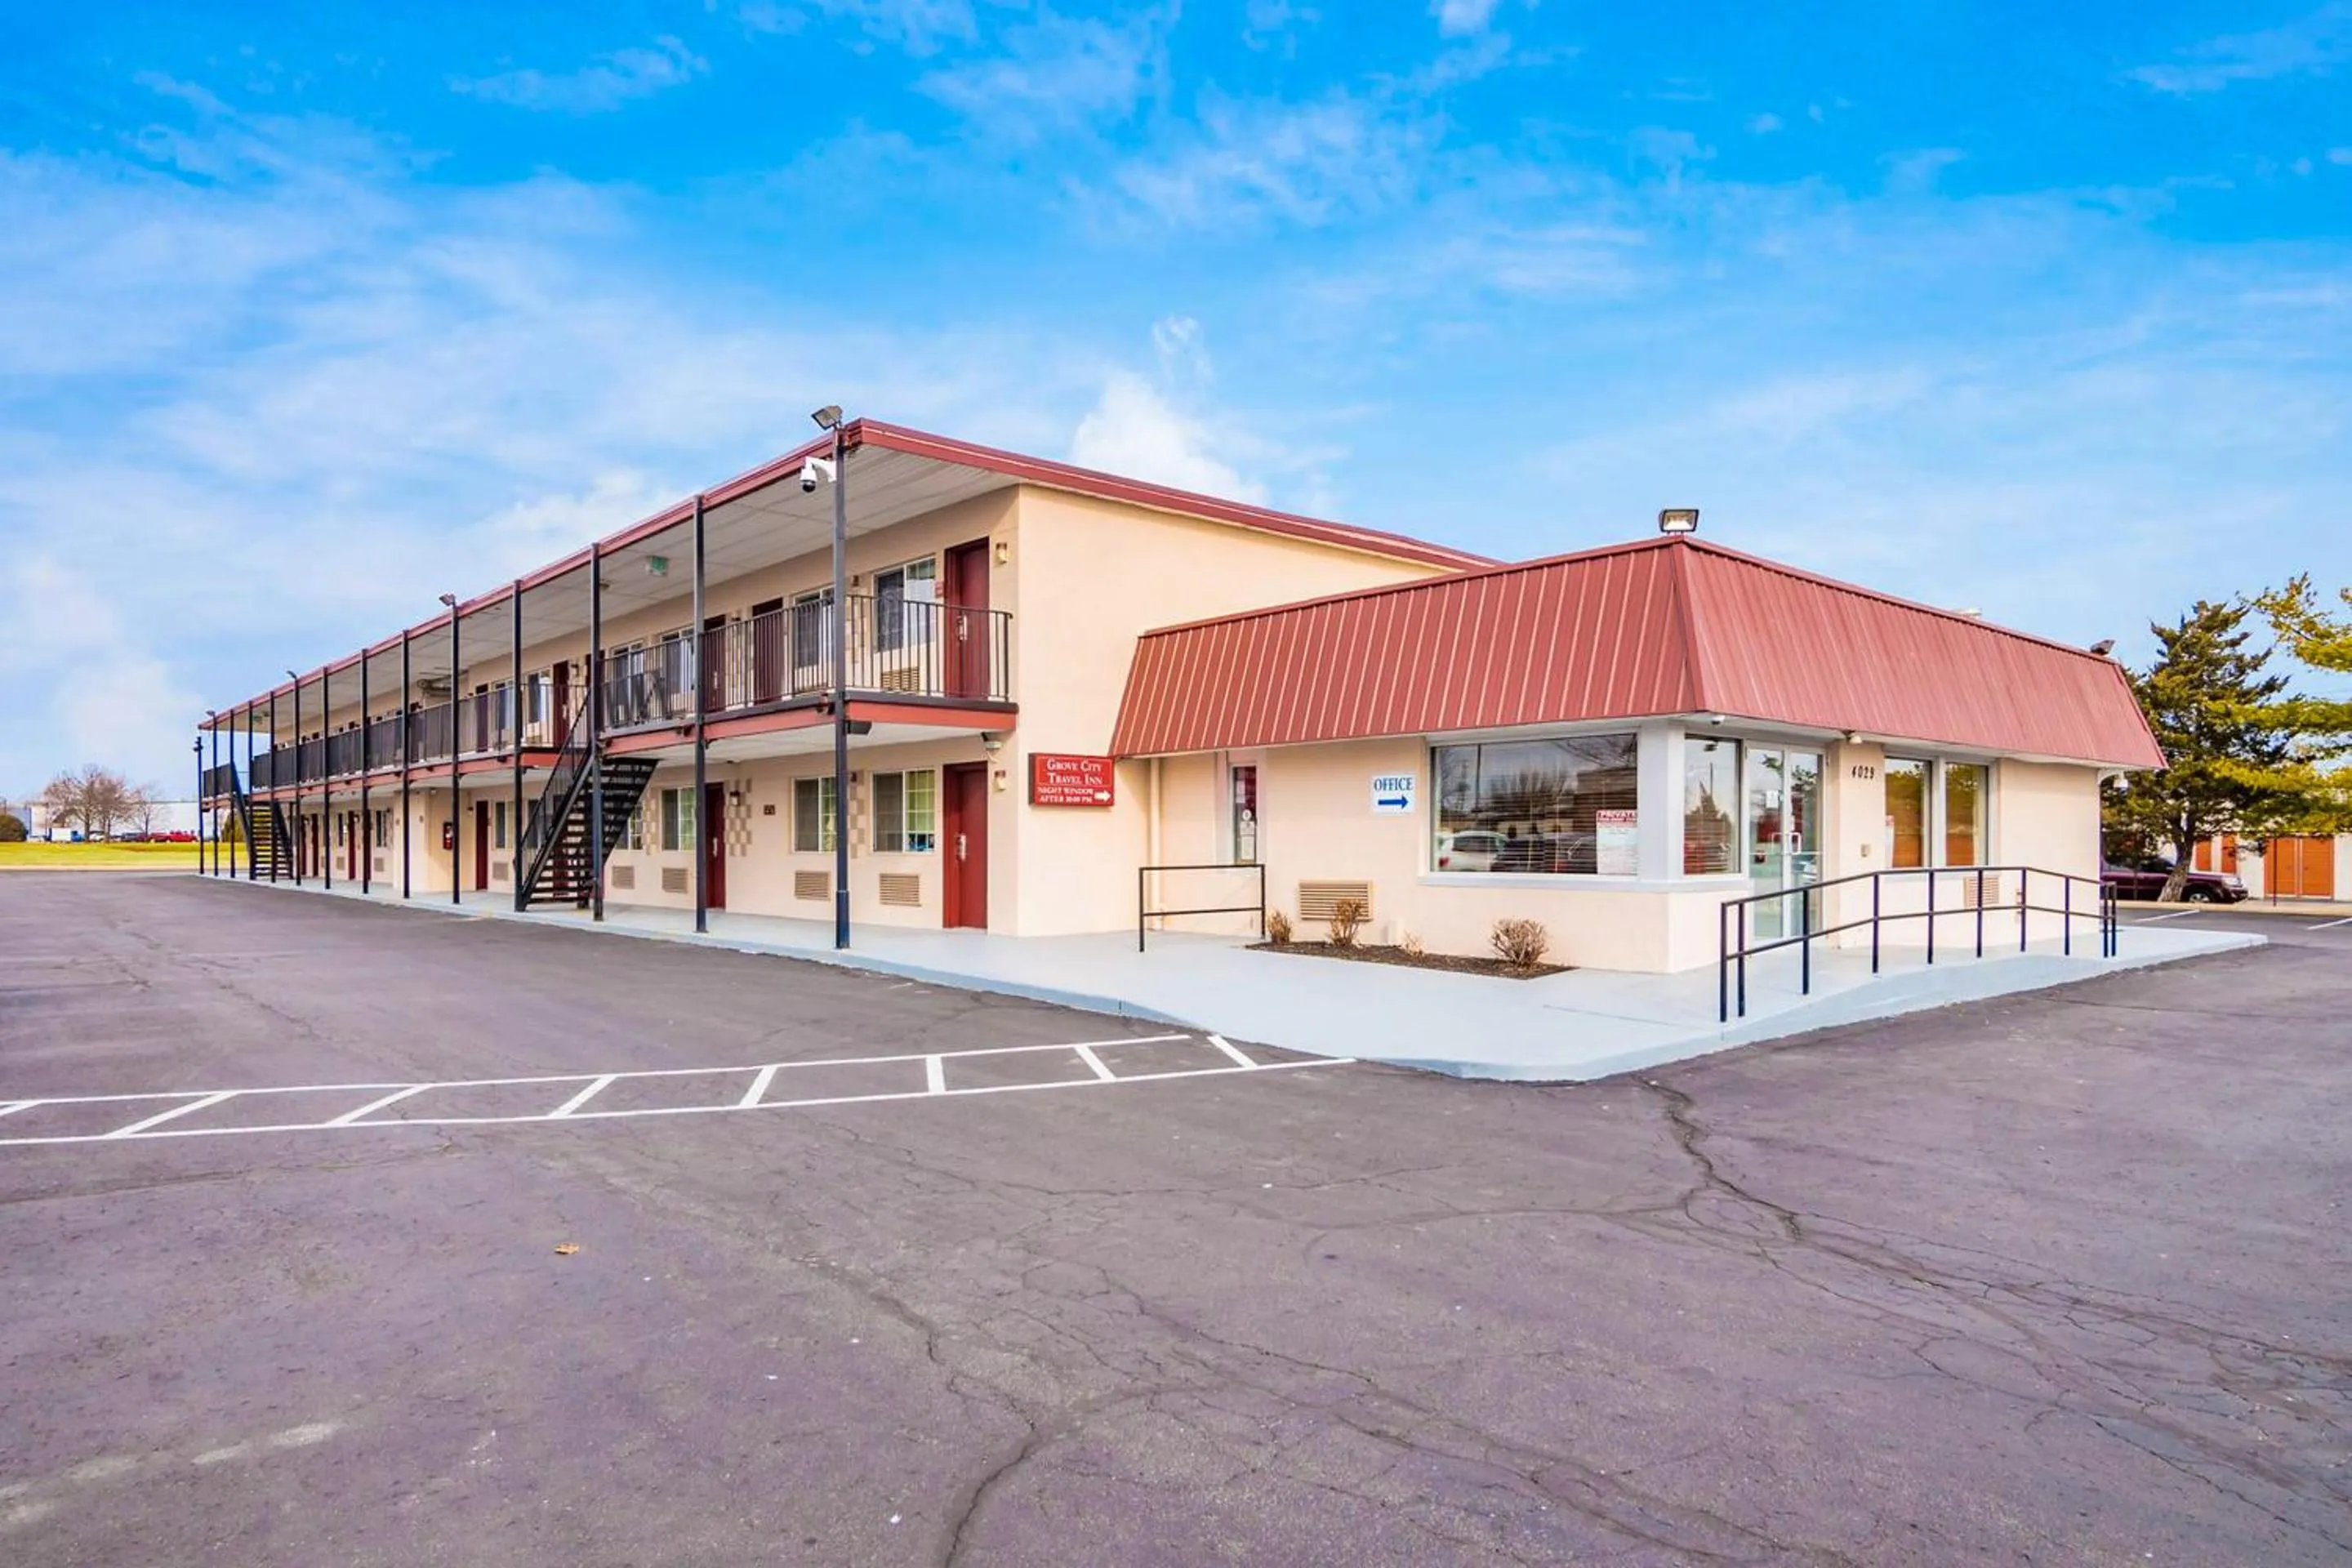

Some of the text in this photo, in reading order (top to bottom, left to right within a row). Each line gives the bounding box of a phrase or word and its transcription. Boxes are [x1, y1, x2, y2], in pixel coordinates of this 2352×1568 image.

[1047, 758, 1101, 772] GROVE CITY
[1047, 772, 1102, 785] TRAVEL INN
[1374, 777, 1413, 791] OFFICE
[1040, 795, 1063, 803] AFTER
